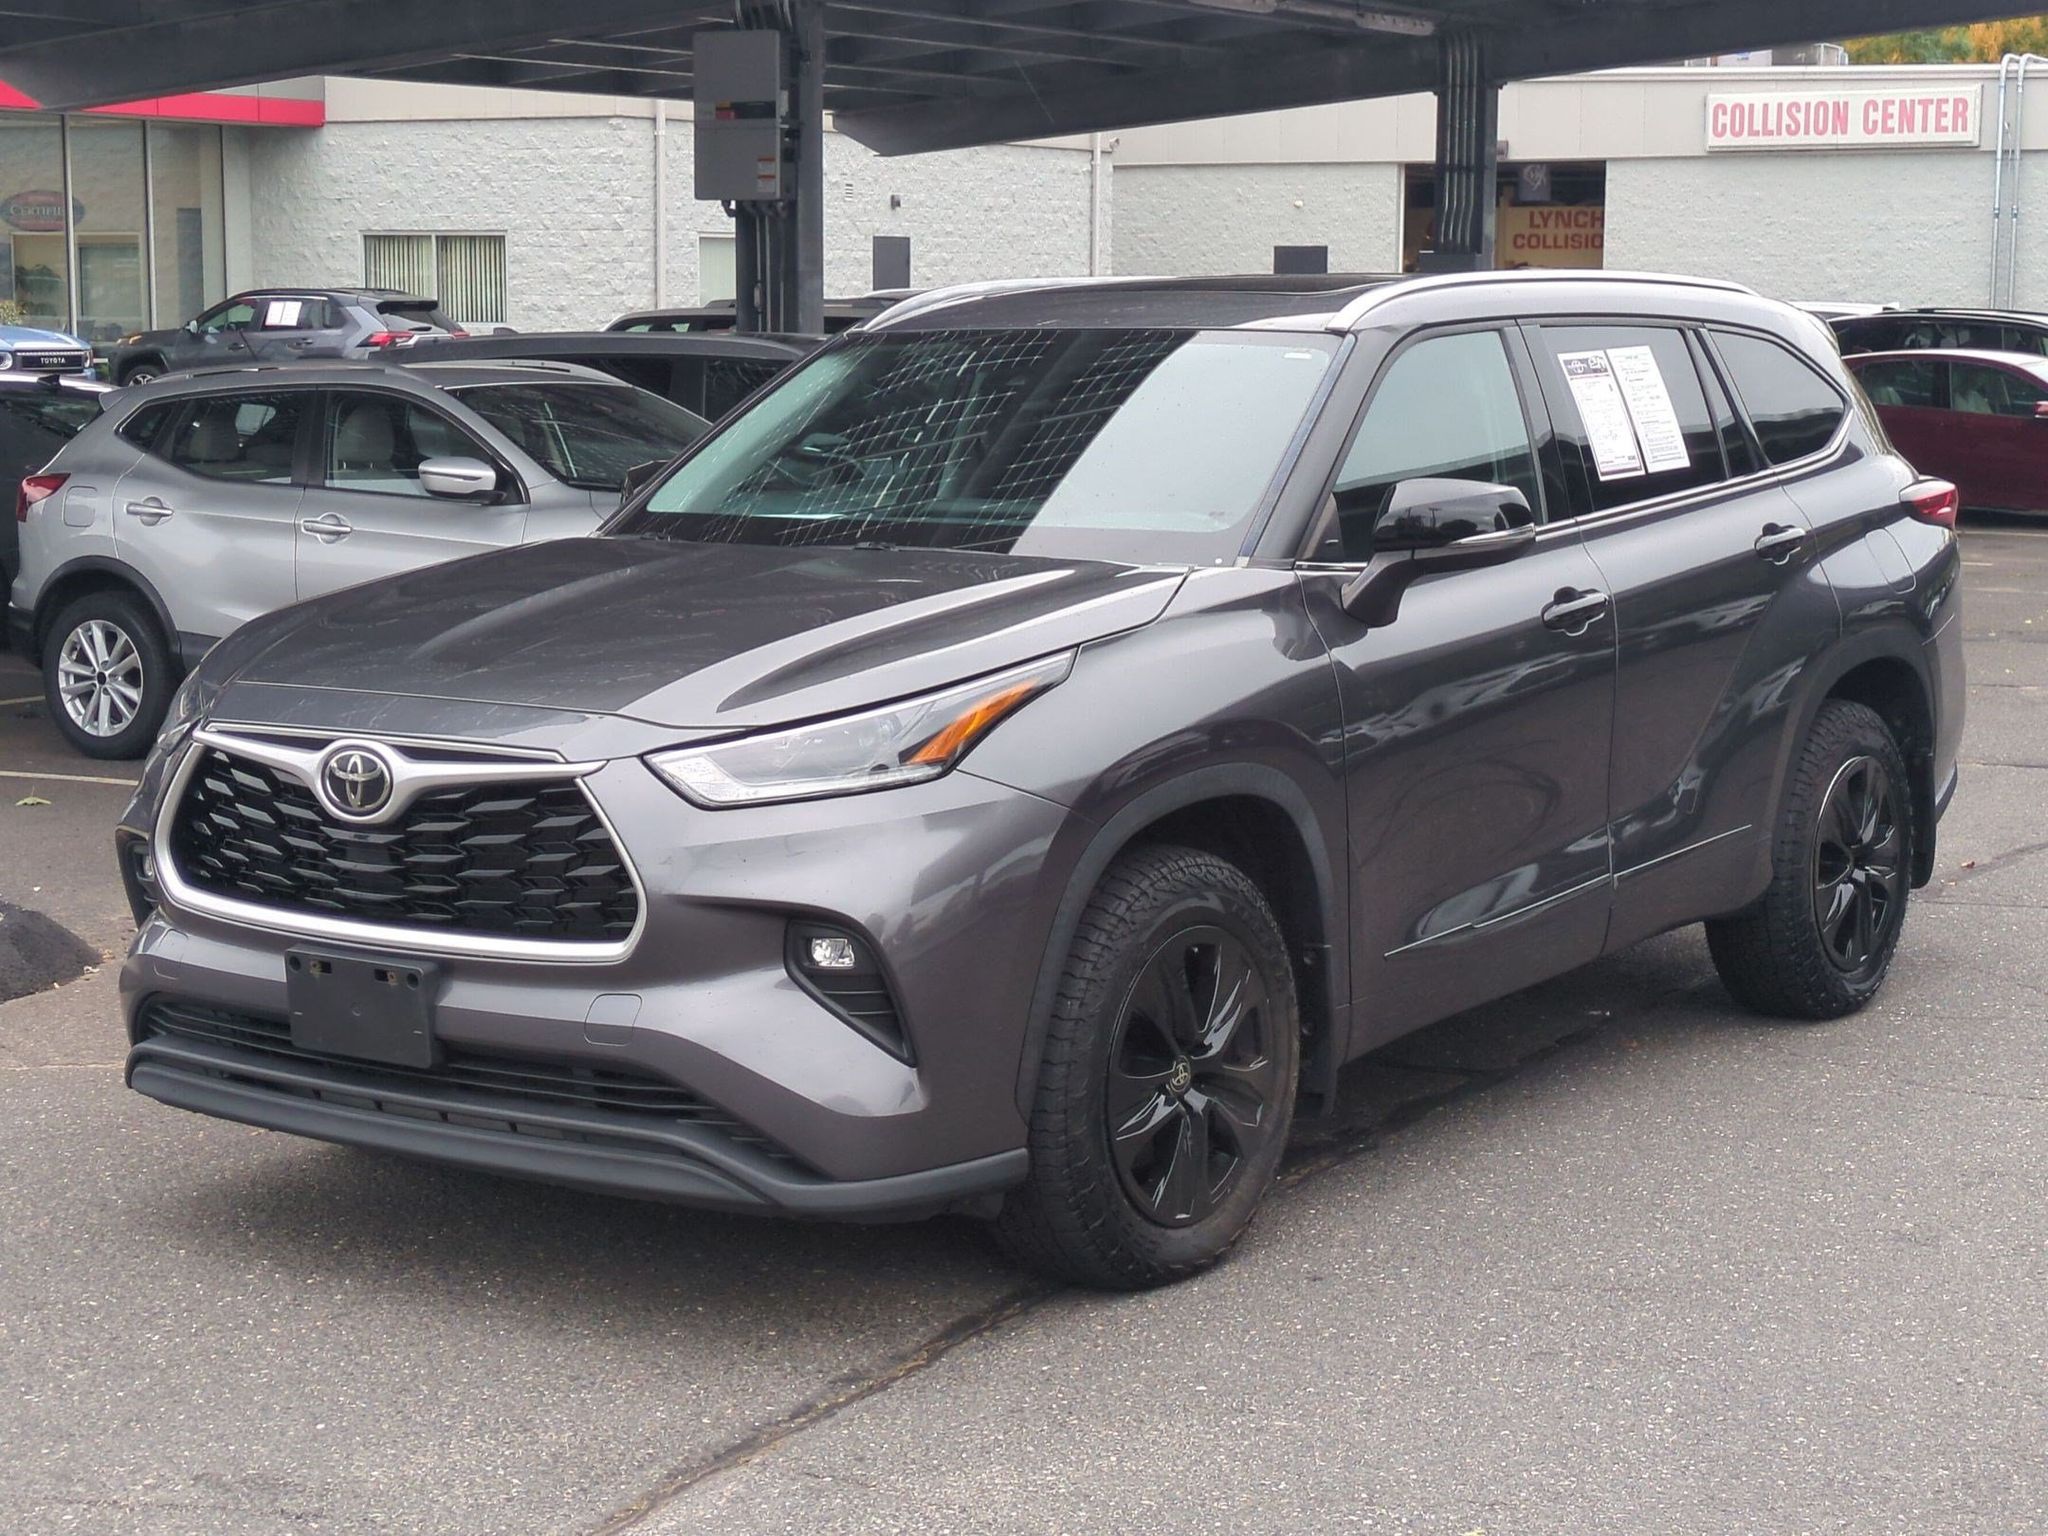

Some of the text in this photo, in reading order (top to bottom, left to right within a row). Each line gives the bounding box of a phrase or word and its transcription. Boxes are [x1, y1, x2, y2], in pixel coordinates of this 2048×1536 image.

[1711, 97, 1968, 138] COLLISION CENTER
[1529, 210, 1604, 229] LYNCH
